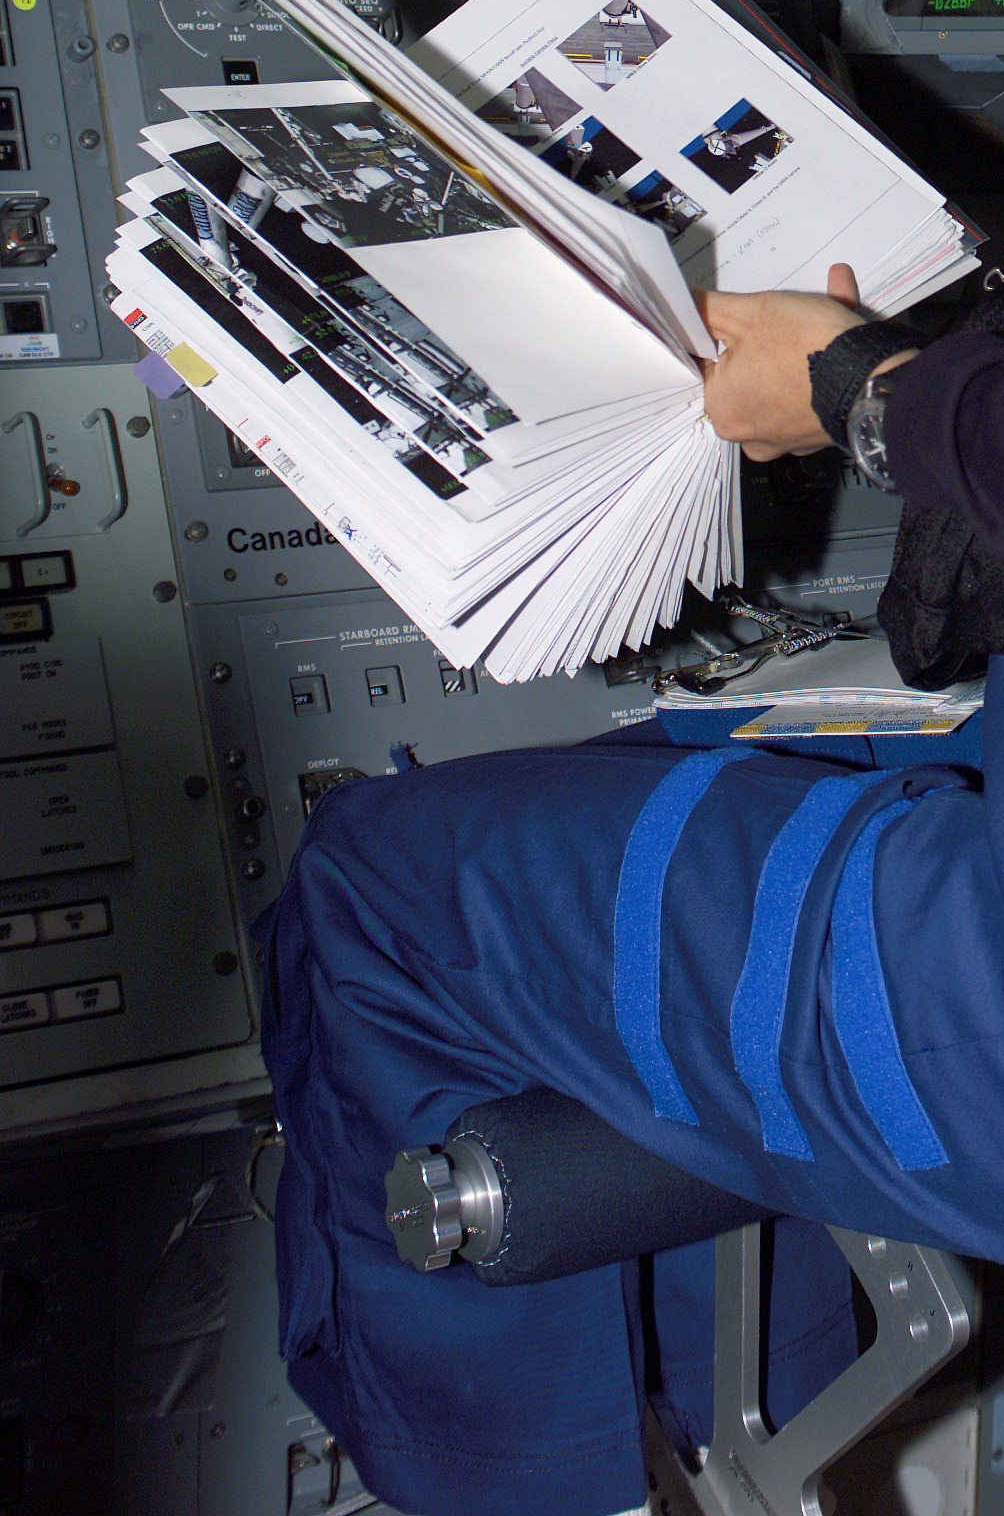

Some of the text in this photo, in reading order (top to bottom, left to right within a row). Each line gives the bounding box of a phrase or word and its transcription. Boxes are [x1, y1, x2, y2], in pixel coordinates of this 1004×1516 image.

[196, 22, 215, 32] CMD
[256, 23, 283, 33] DIRECT
[228, 33, 247, 43] TEST
[230, 72, 251, 82] ENTER
[812, 575, 856, 588] PORT RMS
[828, 583, 866, 595] RETENTION
[339, 626, 400, 642] STARBOARD
[374, 635, 418, 647] RETENTION
[297, 663, 317, 673] RMS
[611, 708, 628, 720] RMS
[307, 757, 340, 770] DEPLOY
